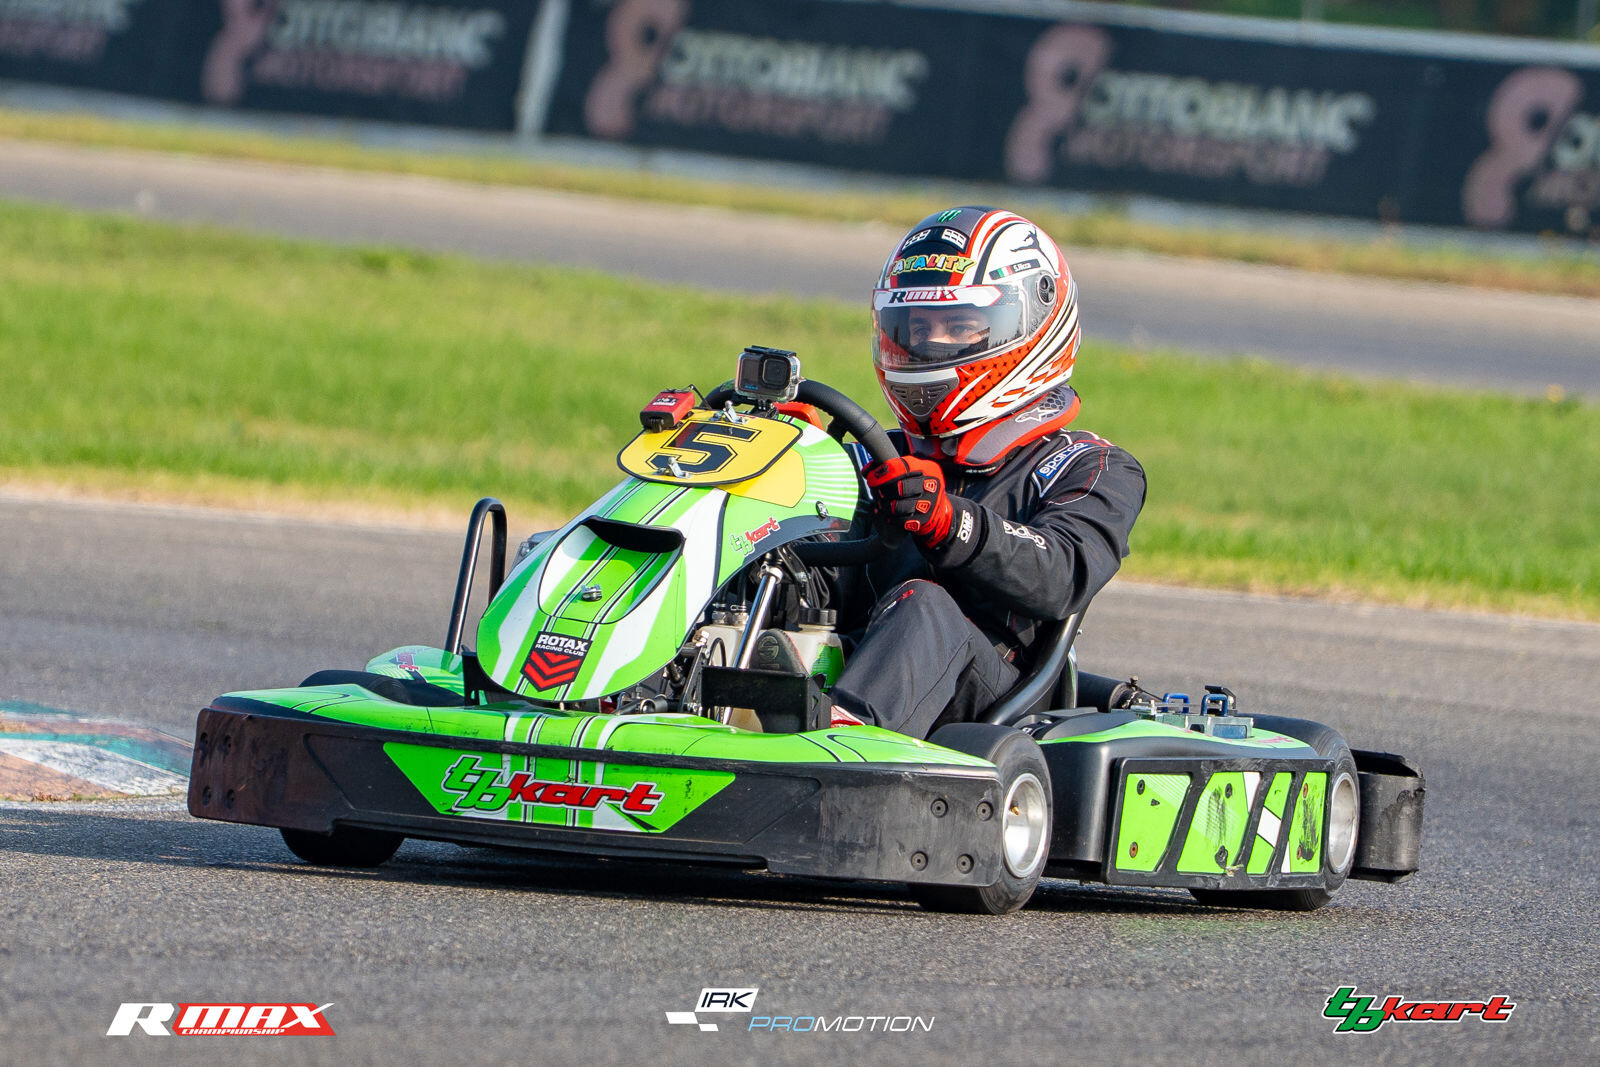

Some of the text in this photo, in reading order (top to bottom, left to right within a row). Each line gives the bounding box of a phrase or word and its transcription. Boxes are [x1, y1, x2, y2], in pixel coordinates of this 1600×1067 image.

[645, 420, 762, 475] 5
[728, 515, 781, 557] tbkart
[956, 509, 974, 544] OMP
[534, 643, 585, 657] RACING CLUB
[537, 634, 588, 652] ROTAX
[441, 754, 666, 815] tbkart
